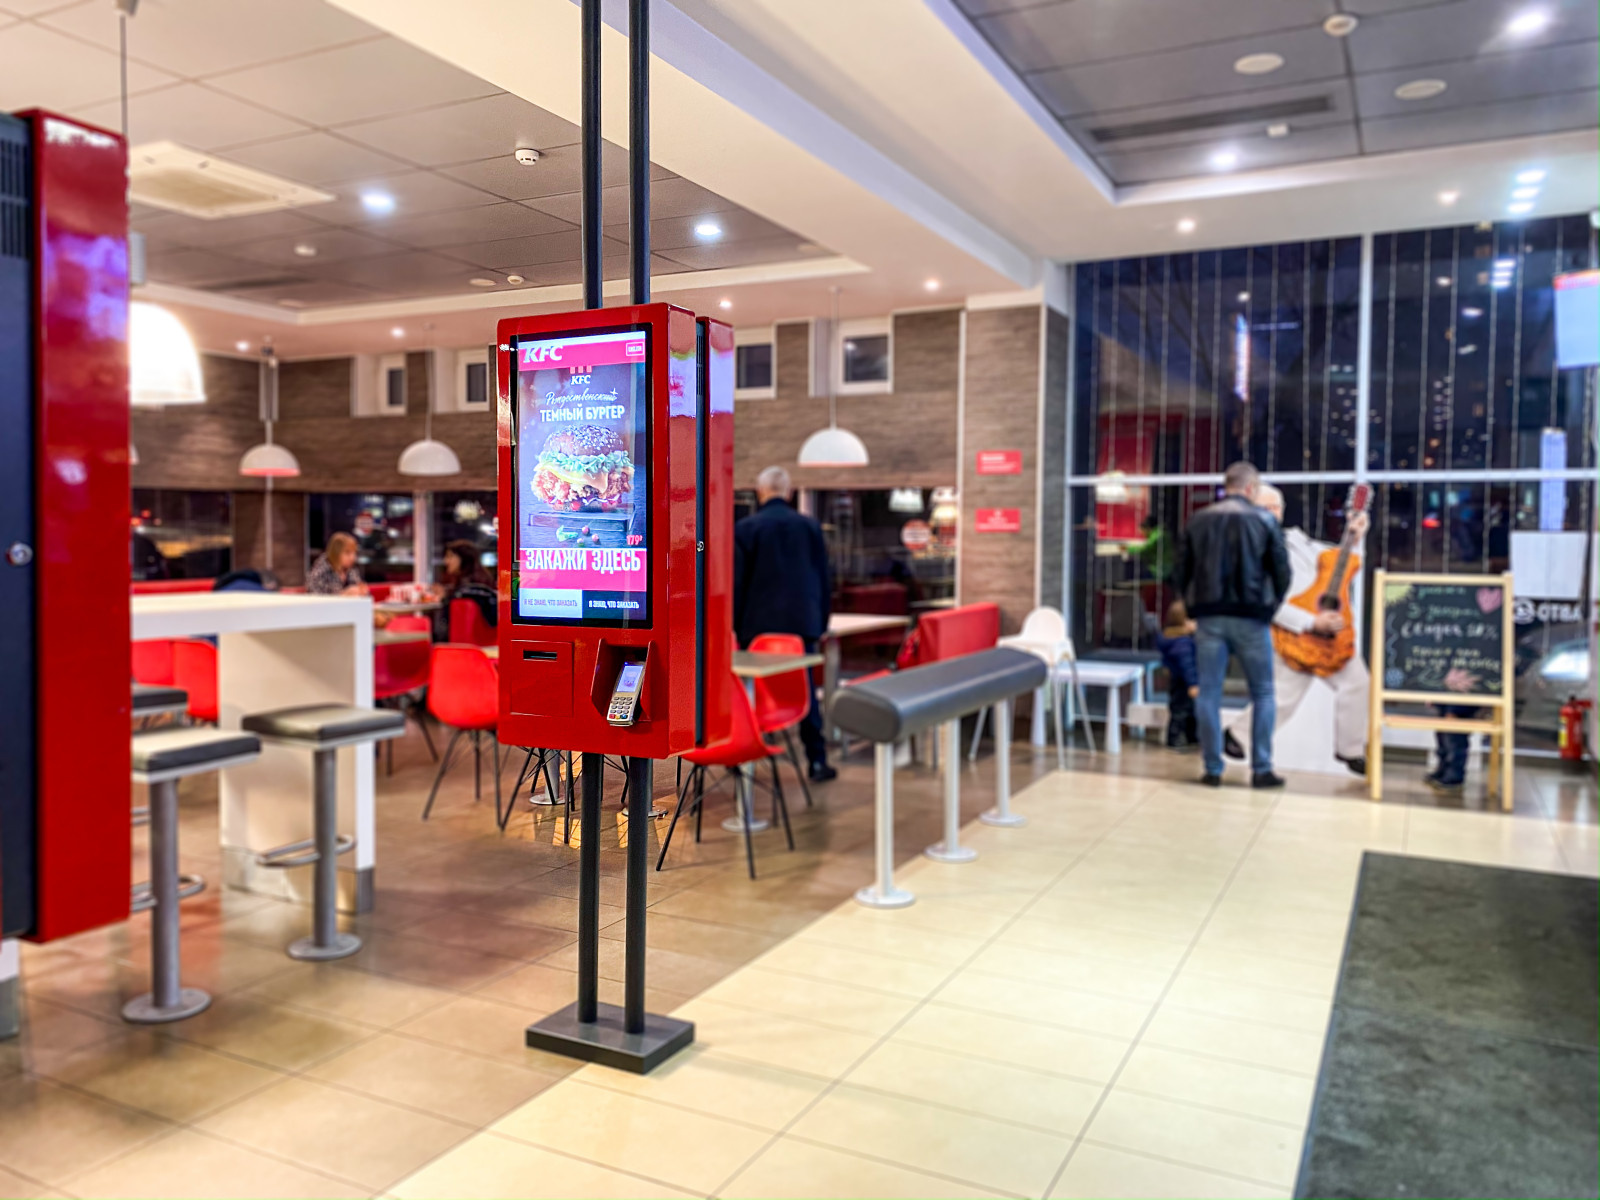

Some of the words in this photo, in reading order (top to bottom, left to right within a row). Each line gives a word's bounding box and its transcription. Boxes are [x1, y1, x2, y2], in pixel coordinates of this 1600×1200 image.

[523, 345, 563, 363] KFC
[571, 375, 591, 385] KFC
[540, 404, 583, 422] ТЕМНЫЙ
[586, 405, 625, 420] БУРГЕР
[525, 549, 587, 570] ЗАКАЖИ
[592, 550, 641, 574] ЗДЕСЬ
